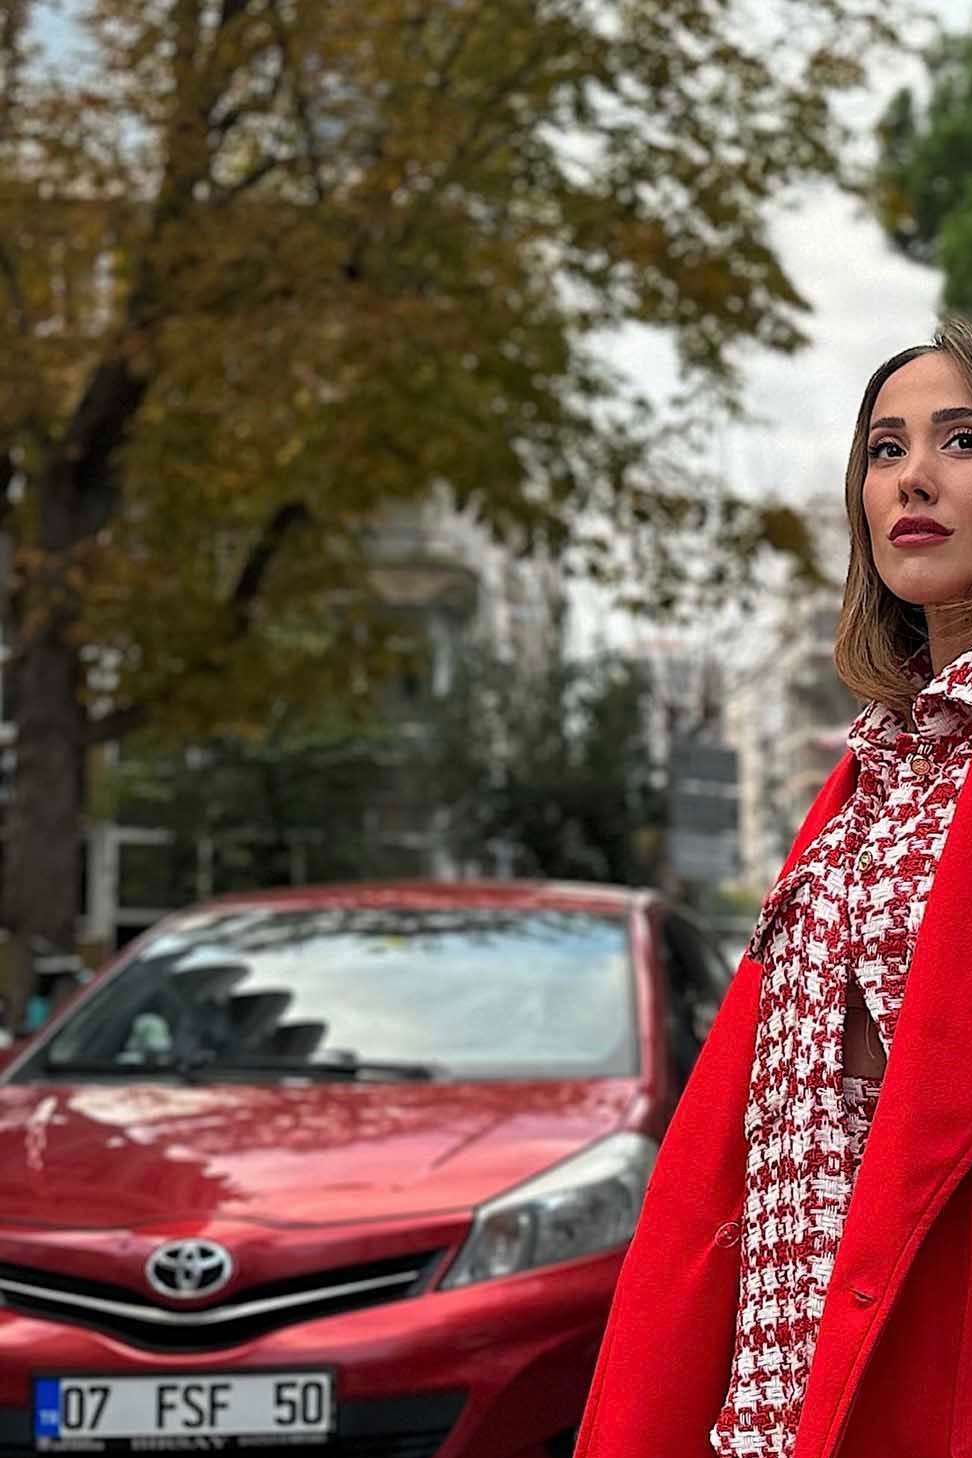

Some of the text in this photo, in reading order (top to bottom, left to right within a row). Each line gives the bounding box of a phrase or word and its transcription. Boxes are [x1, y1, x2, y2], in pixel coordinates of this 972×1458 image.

[64, 1382, 323, 1430] 07 FSF 50
